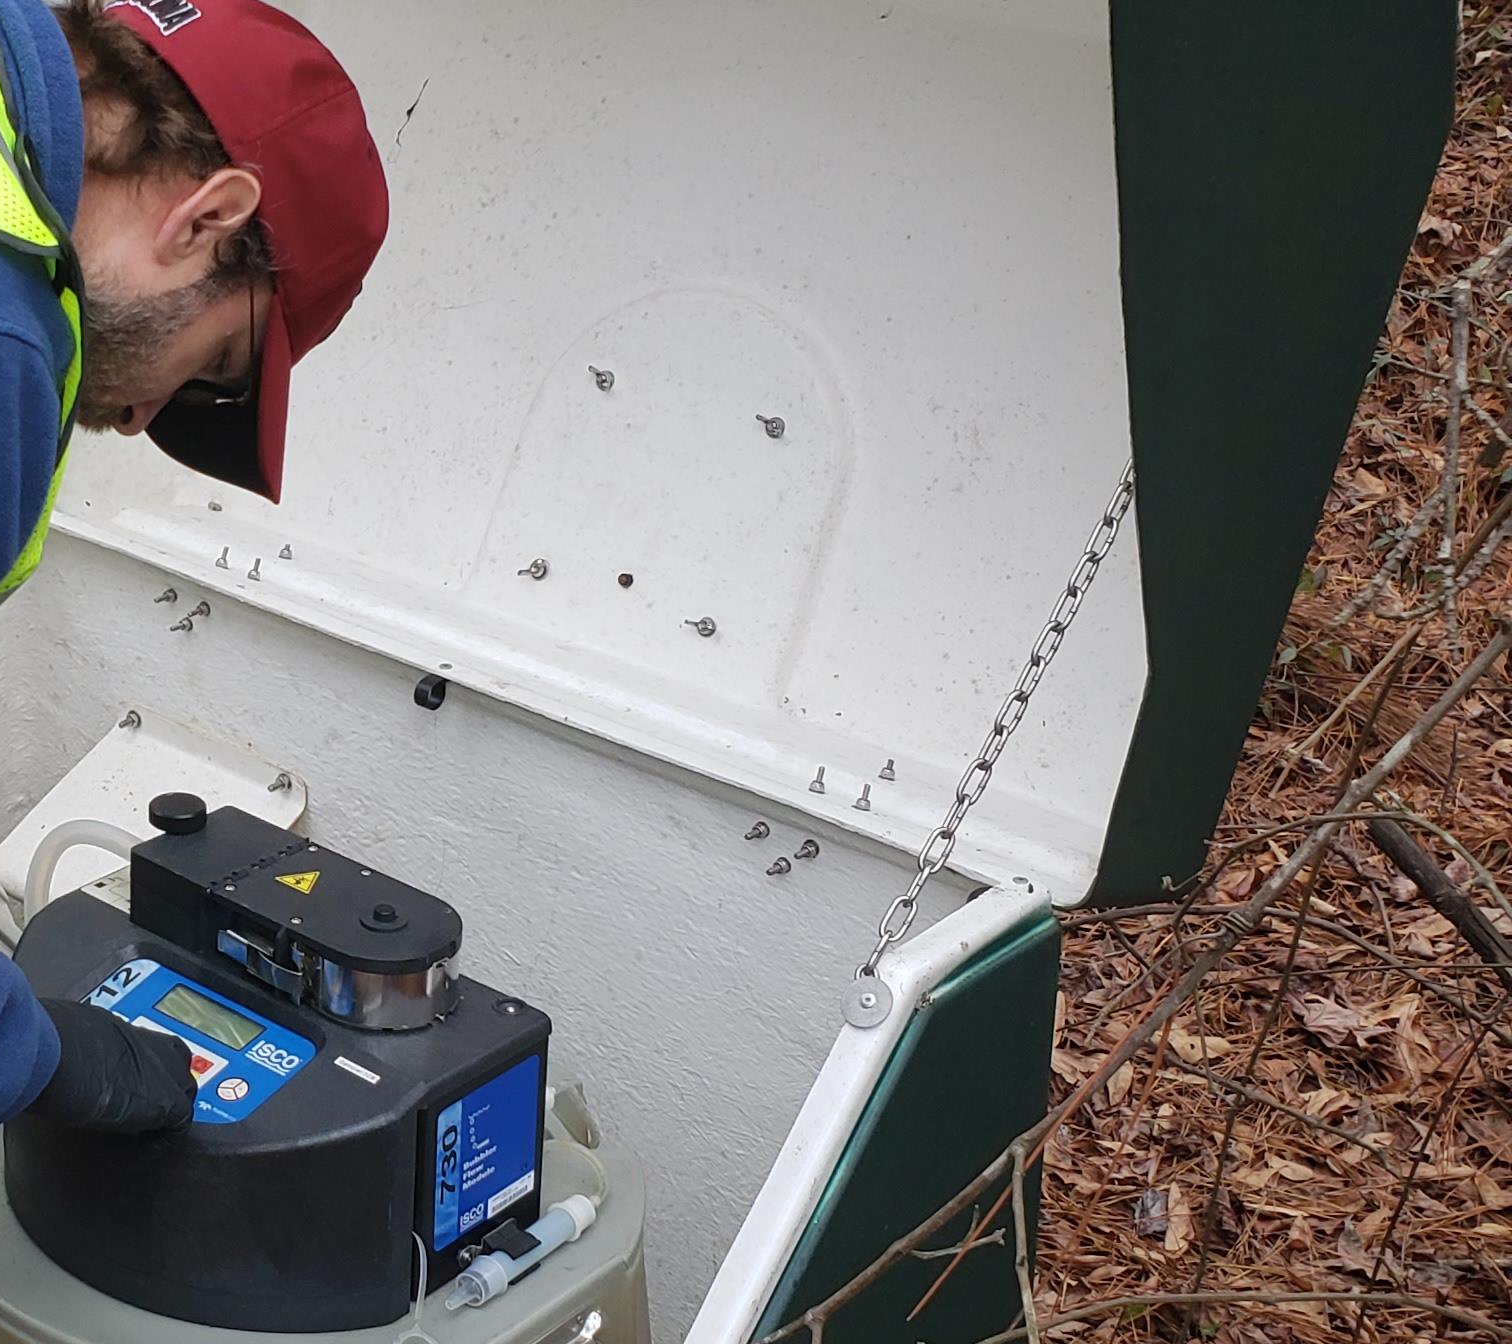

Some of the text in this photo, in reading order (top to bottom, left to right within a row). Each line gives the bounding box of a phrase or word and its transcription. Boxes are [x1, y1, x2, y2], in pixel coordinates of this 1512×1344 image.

[250, 1039, 300, 1069] ISCO
[440, 1124, 457, 1205] 730
[460, 1203, 484, 1227] ISCO
